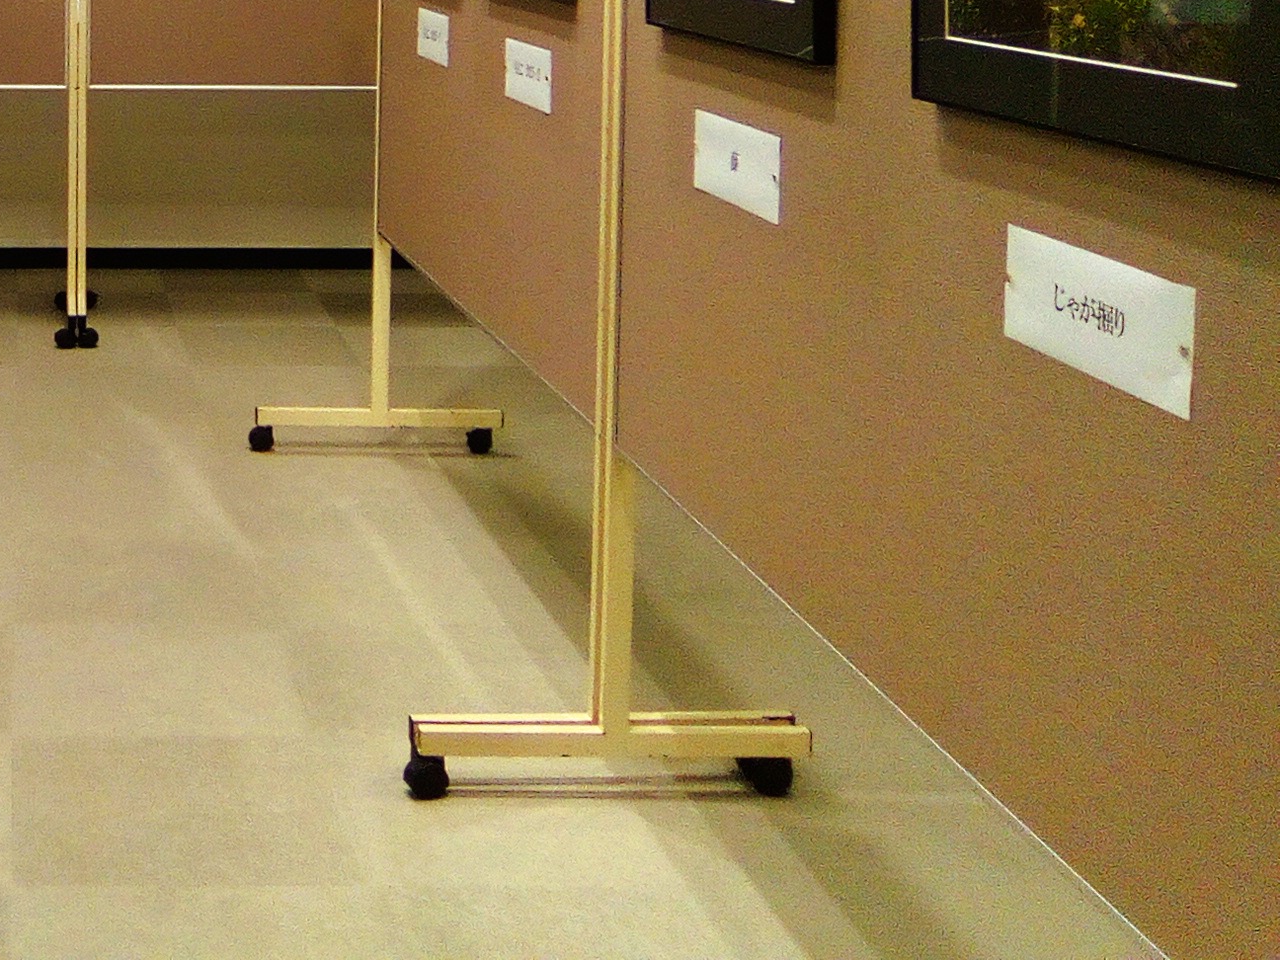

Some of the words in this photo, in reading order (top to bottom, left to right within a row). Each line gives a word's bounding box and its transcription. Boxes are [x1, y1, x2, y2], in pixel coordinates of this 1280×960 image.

[1053, 282, 1125, 338] じゃが掘り
